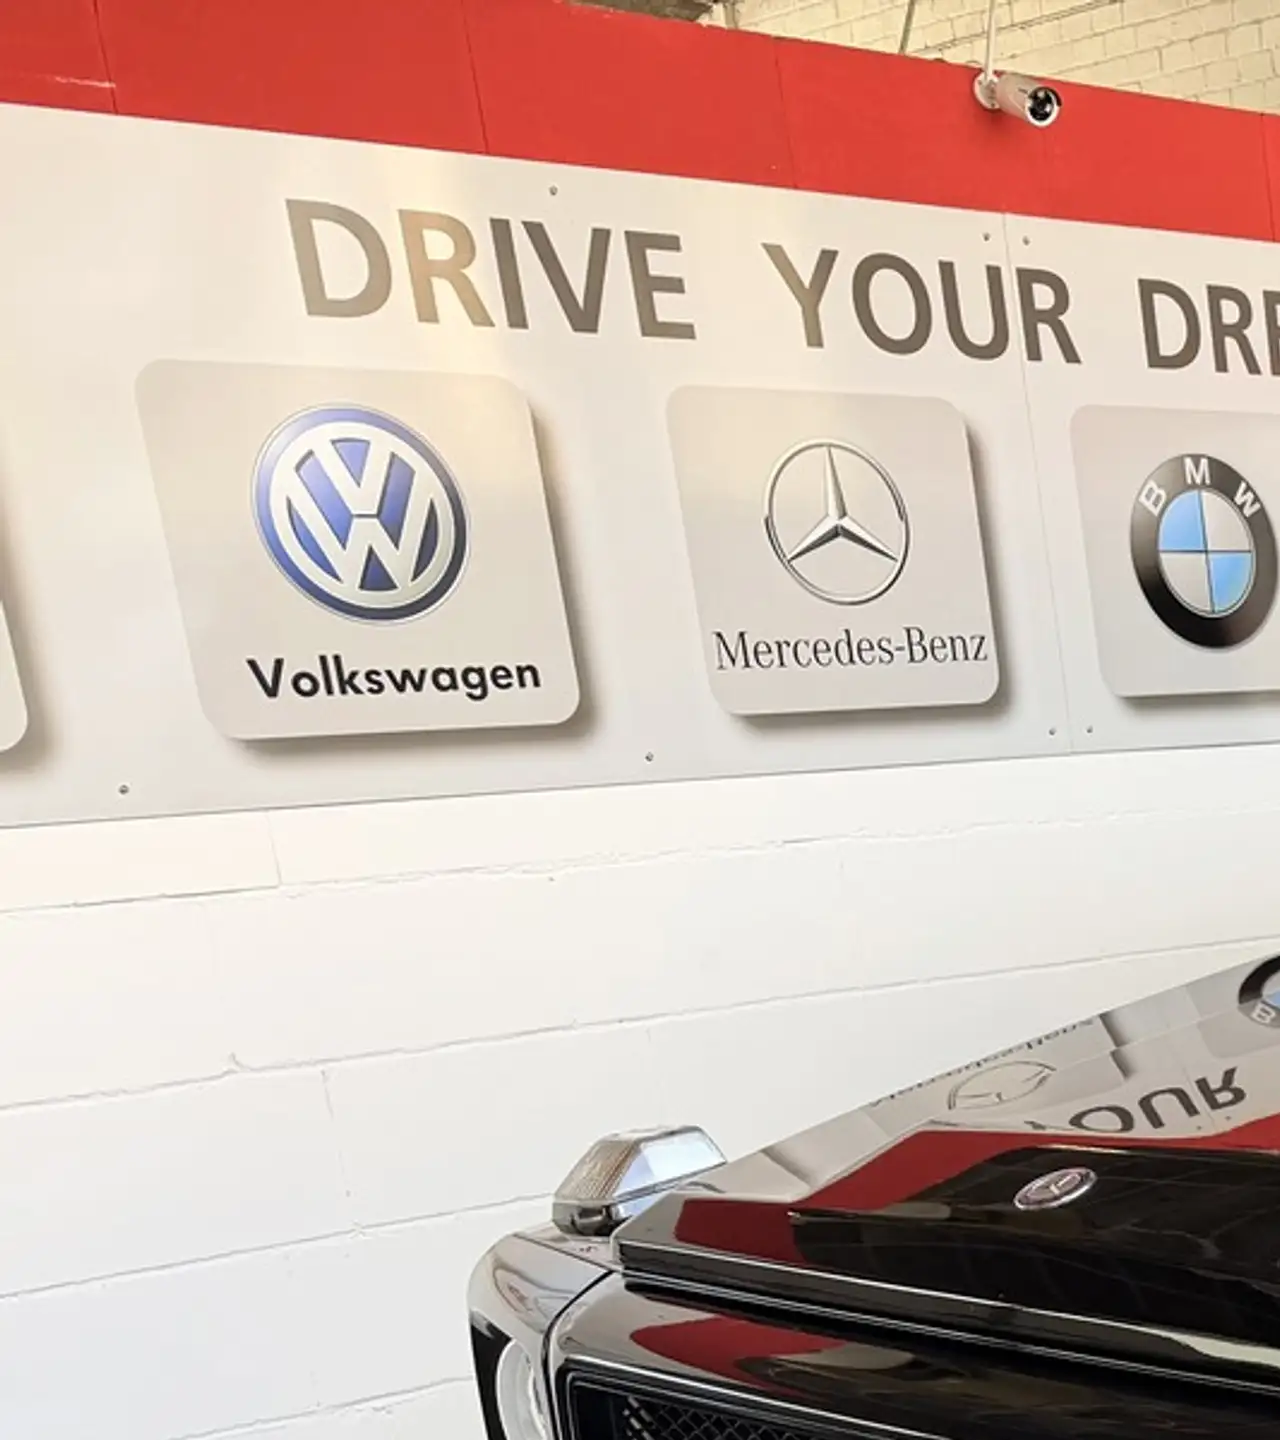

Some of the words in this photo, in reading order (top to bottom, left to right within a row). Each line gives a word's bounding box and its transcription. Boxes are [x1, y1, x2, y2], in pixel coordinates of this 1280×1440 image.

[285, 197, 697, 341] DRIVE
[762, 241, 1082, 365] YOUR
[1138, 456, 1262, 519] BMW
[714, 623, 989, 672] Mercedes-Benz
[246, 654, 542, 703] Volkswagen
